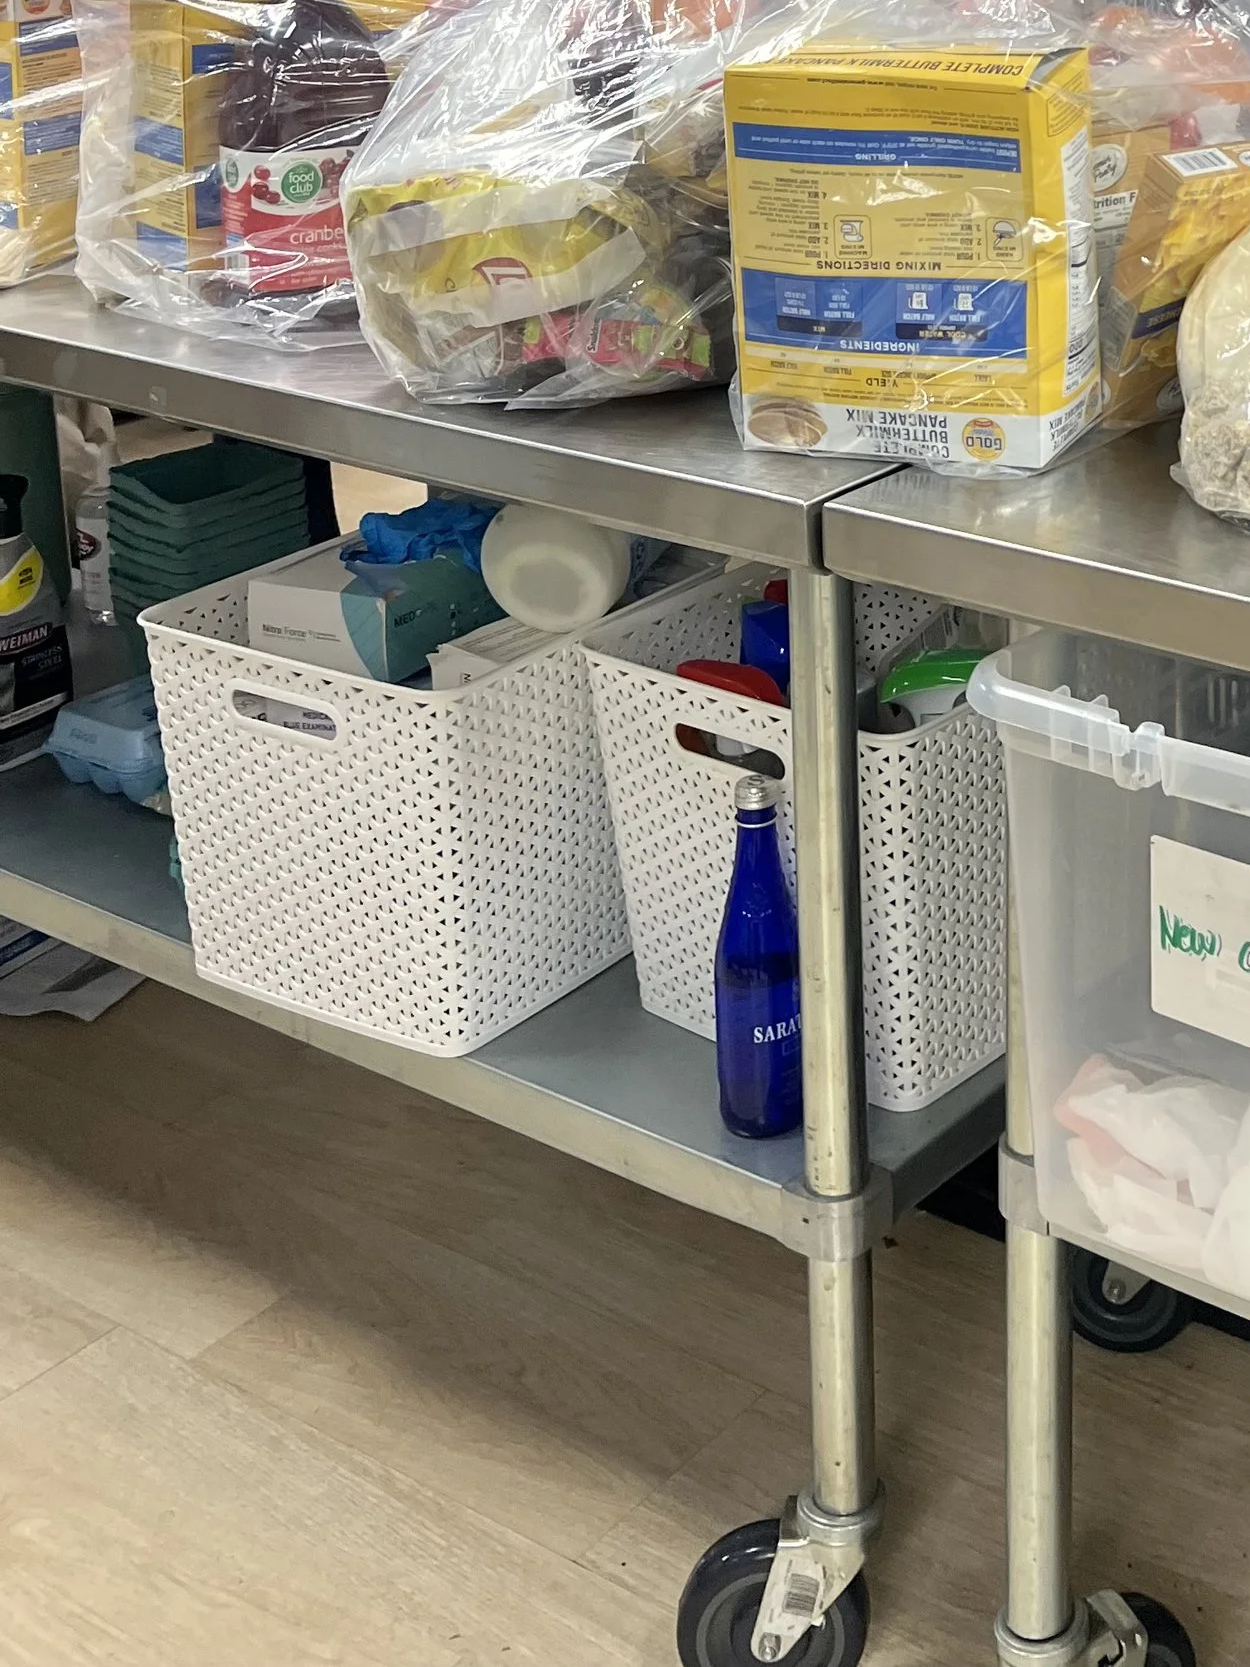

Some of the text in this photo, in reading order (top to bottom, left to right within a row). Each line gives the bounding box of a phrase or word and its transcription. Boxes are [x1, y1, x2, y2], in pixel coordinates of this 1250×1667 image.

[846, 57, 942, 72] BUTTERMILK
[940, 61, 1024, 76] COMPLETE
[854, 152, 896, 161] GRILLING
[288, 171, 314, 183] food
[289, 182, 314, 194] club
[807, 190, 820, 199] MIX
[1130, 192, 1136, 202] F
[808, 222, 820, 230] MIX
[290, 224, 344, 244] cranbe
[808, 236, 820, 244] ADD
[960, 238, 974, 246] ADD
[956, 252, 974, 260] POUR
[816, 260, 942, 270] MIXING DIRECTIONS
[812, 324, 826, 332] MIX
[918, 329, 966, 338] COOL WATER
[839, 340, 920, 352] INGREDIENTS
[846, 406, 947, 429] PANCAKE MIX
[1049, 416, 1063, 432] MIX
[852, 424, 948, 444] BUTTERMILK
[964, 436, 1002, 451] GOLD
[0, 624, 48, 652] WEIMAN
[20, 644, 64, 668] STAINLESS
[38, 656, 62, 670] STEEL
[284, 720, 336, 732] BLUE EXAMINAT
[1158, 904, 1222, 962] New
